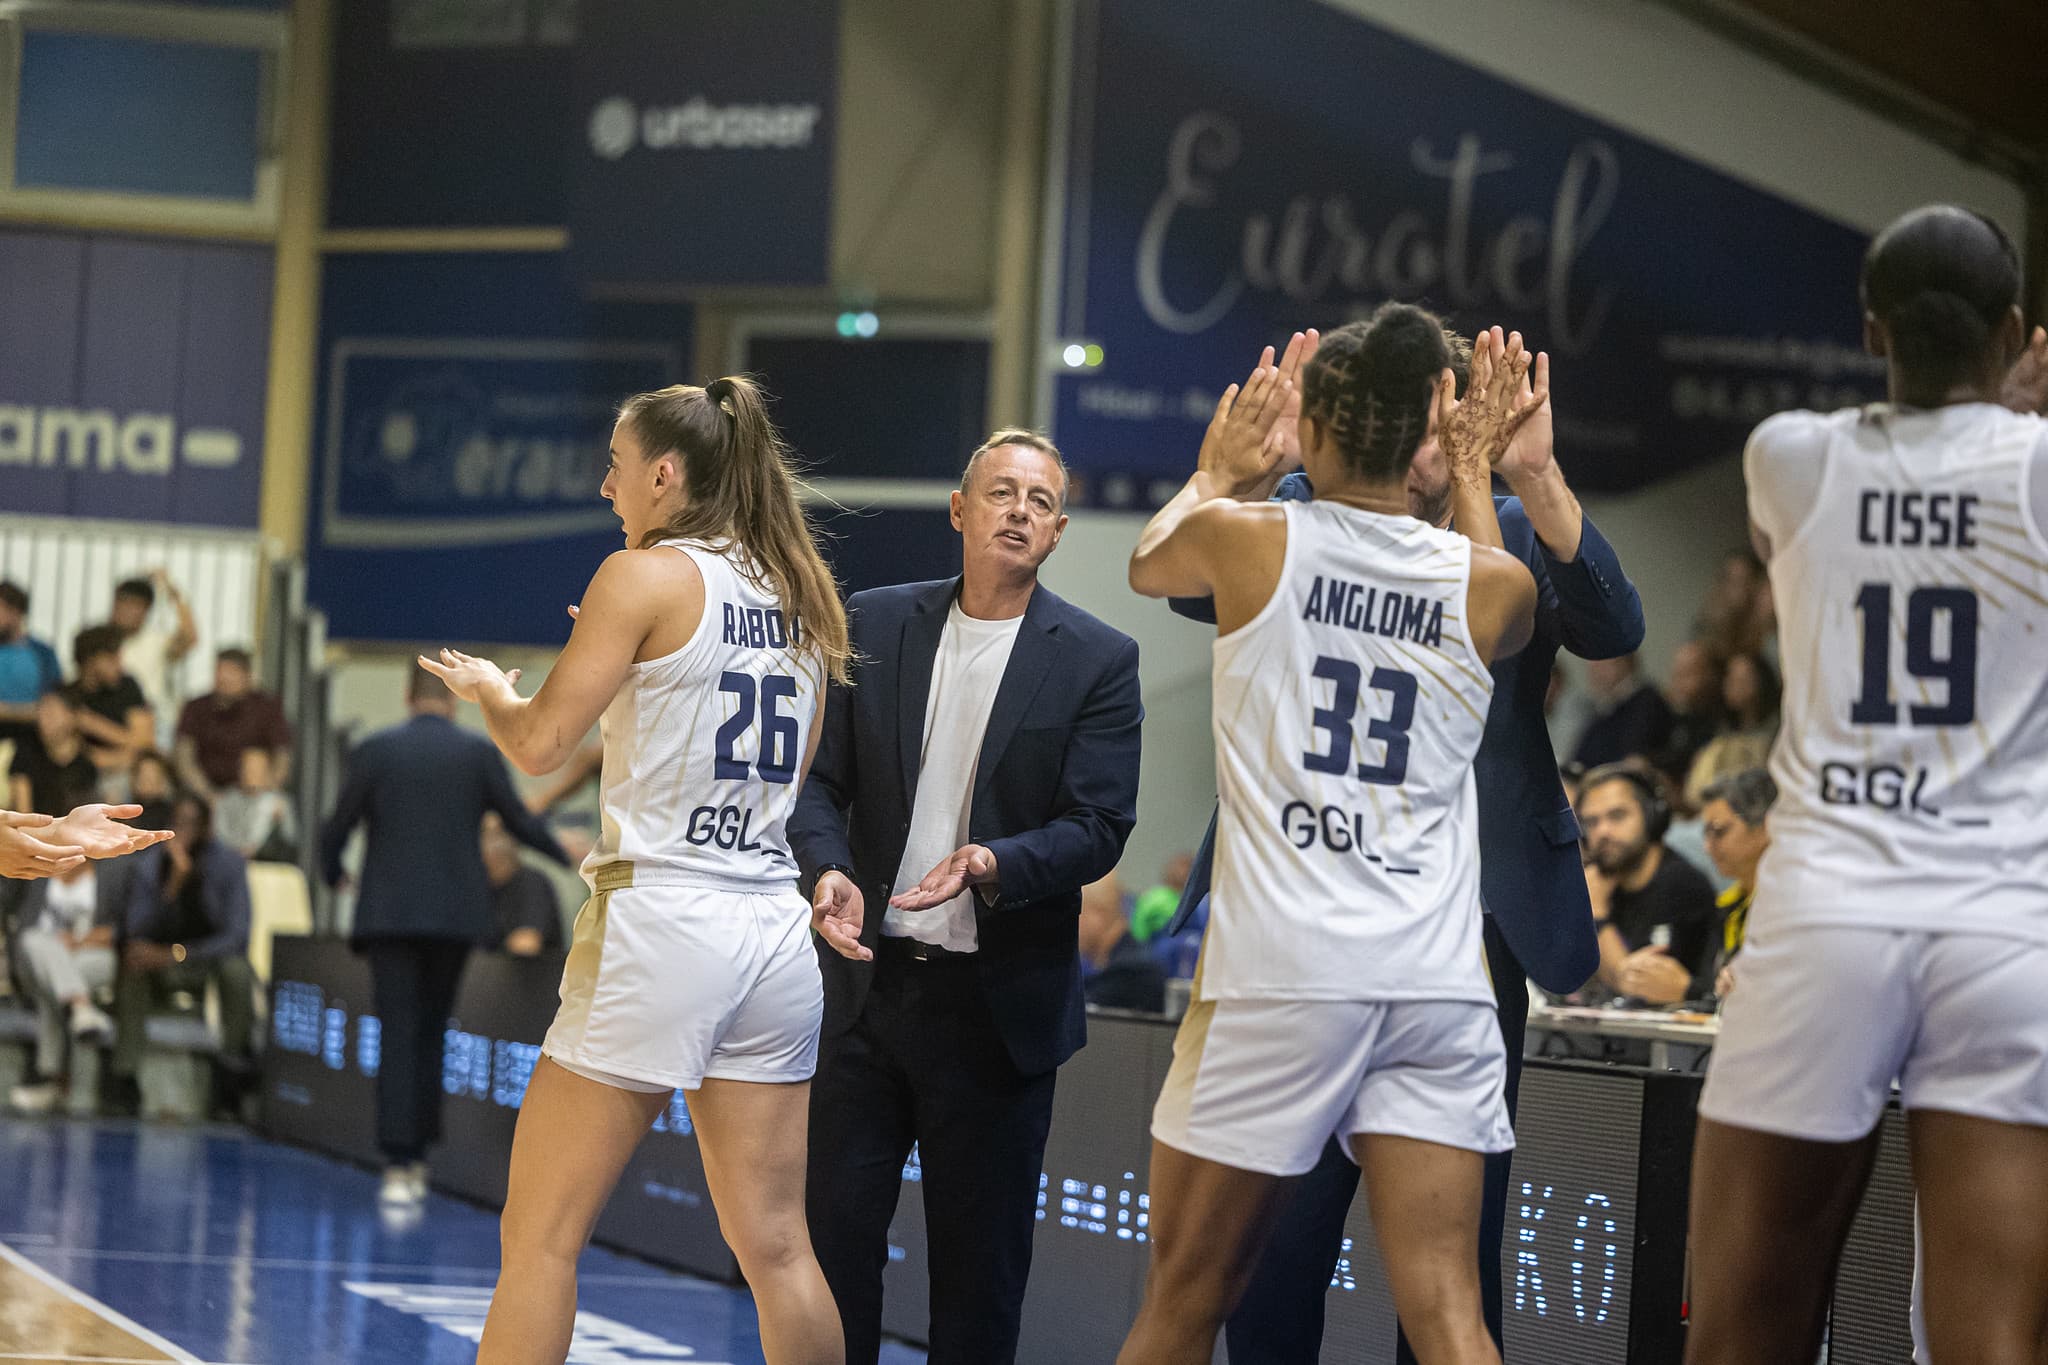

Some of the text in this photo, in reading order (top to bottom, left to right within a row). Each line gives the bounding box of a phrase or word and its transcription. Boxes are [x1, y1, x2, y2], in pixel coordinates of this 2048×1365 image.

[1858, 488, 1980, 549] CISSE
[1303, 576, 1444, 648] ANGLOMA
[1850, 582, 1979, 727] 19
[714, 671, 798, 784] 26
[1303, 655, 1418, 786] 33
